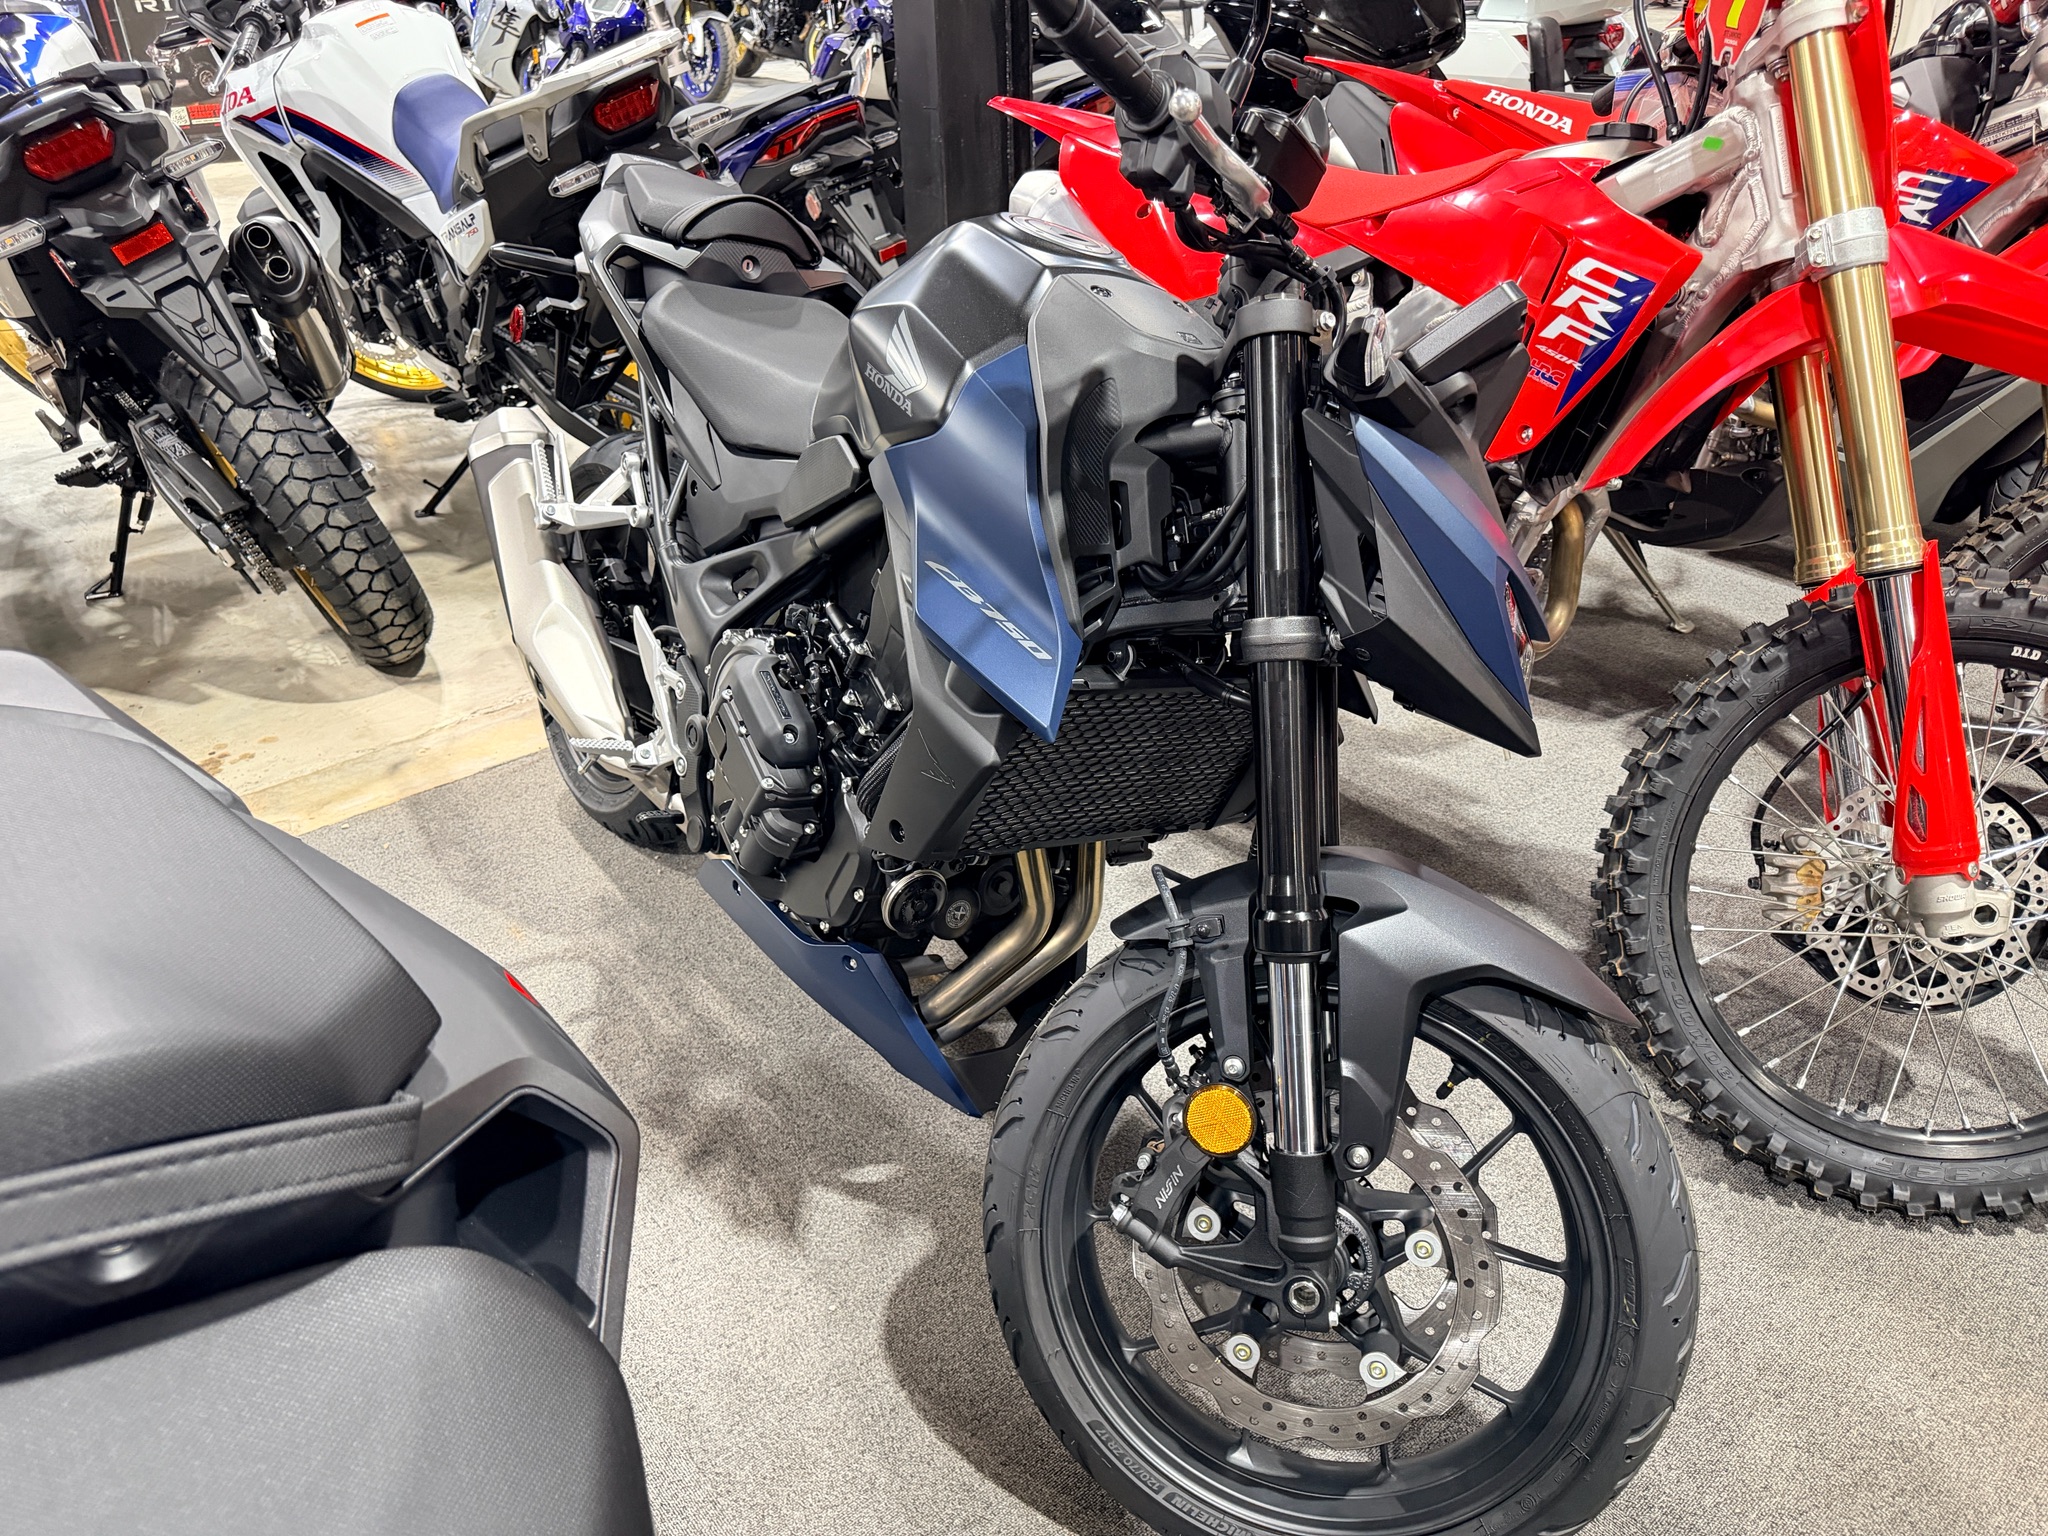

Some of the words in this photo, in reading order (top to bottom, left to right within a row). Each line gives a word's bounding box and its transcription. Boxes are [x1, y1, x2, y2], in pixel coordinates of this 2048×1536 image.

[491, 0, 521, 46] 隼
[1482, 89, 1573, 135] HONDA
[440, 213, 476, 244] TRANSALP
[465, 226, 479, 238] 750
[1538, 257, 1640, 347] CRF
[1527, 358, 1566, 387] HRC
[1535, 344, 1583, 372] 450R
[864, 361, 913, 418] HONDA
[924, 560, 1053, 660] CB750
[2011, 645, 2042, 661] D.I.D
[1155, 1164, 1184, 1209] NISSIN
[1095, 1428, 1112, 1441] 17
[1107, 1439, 1123, 1456] ZR
[1123, 1454, 1162, 1492] 120/70
